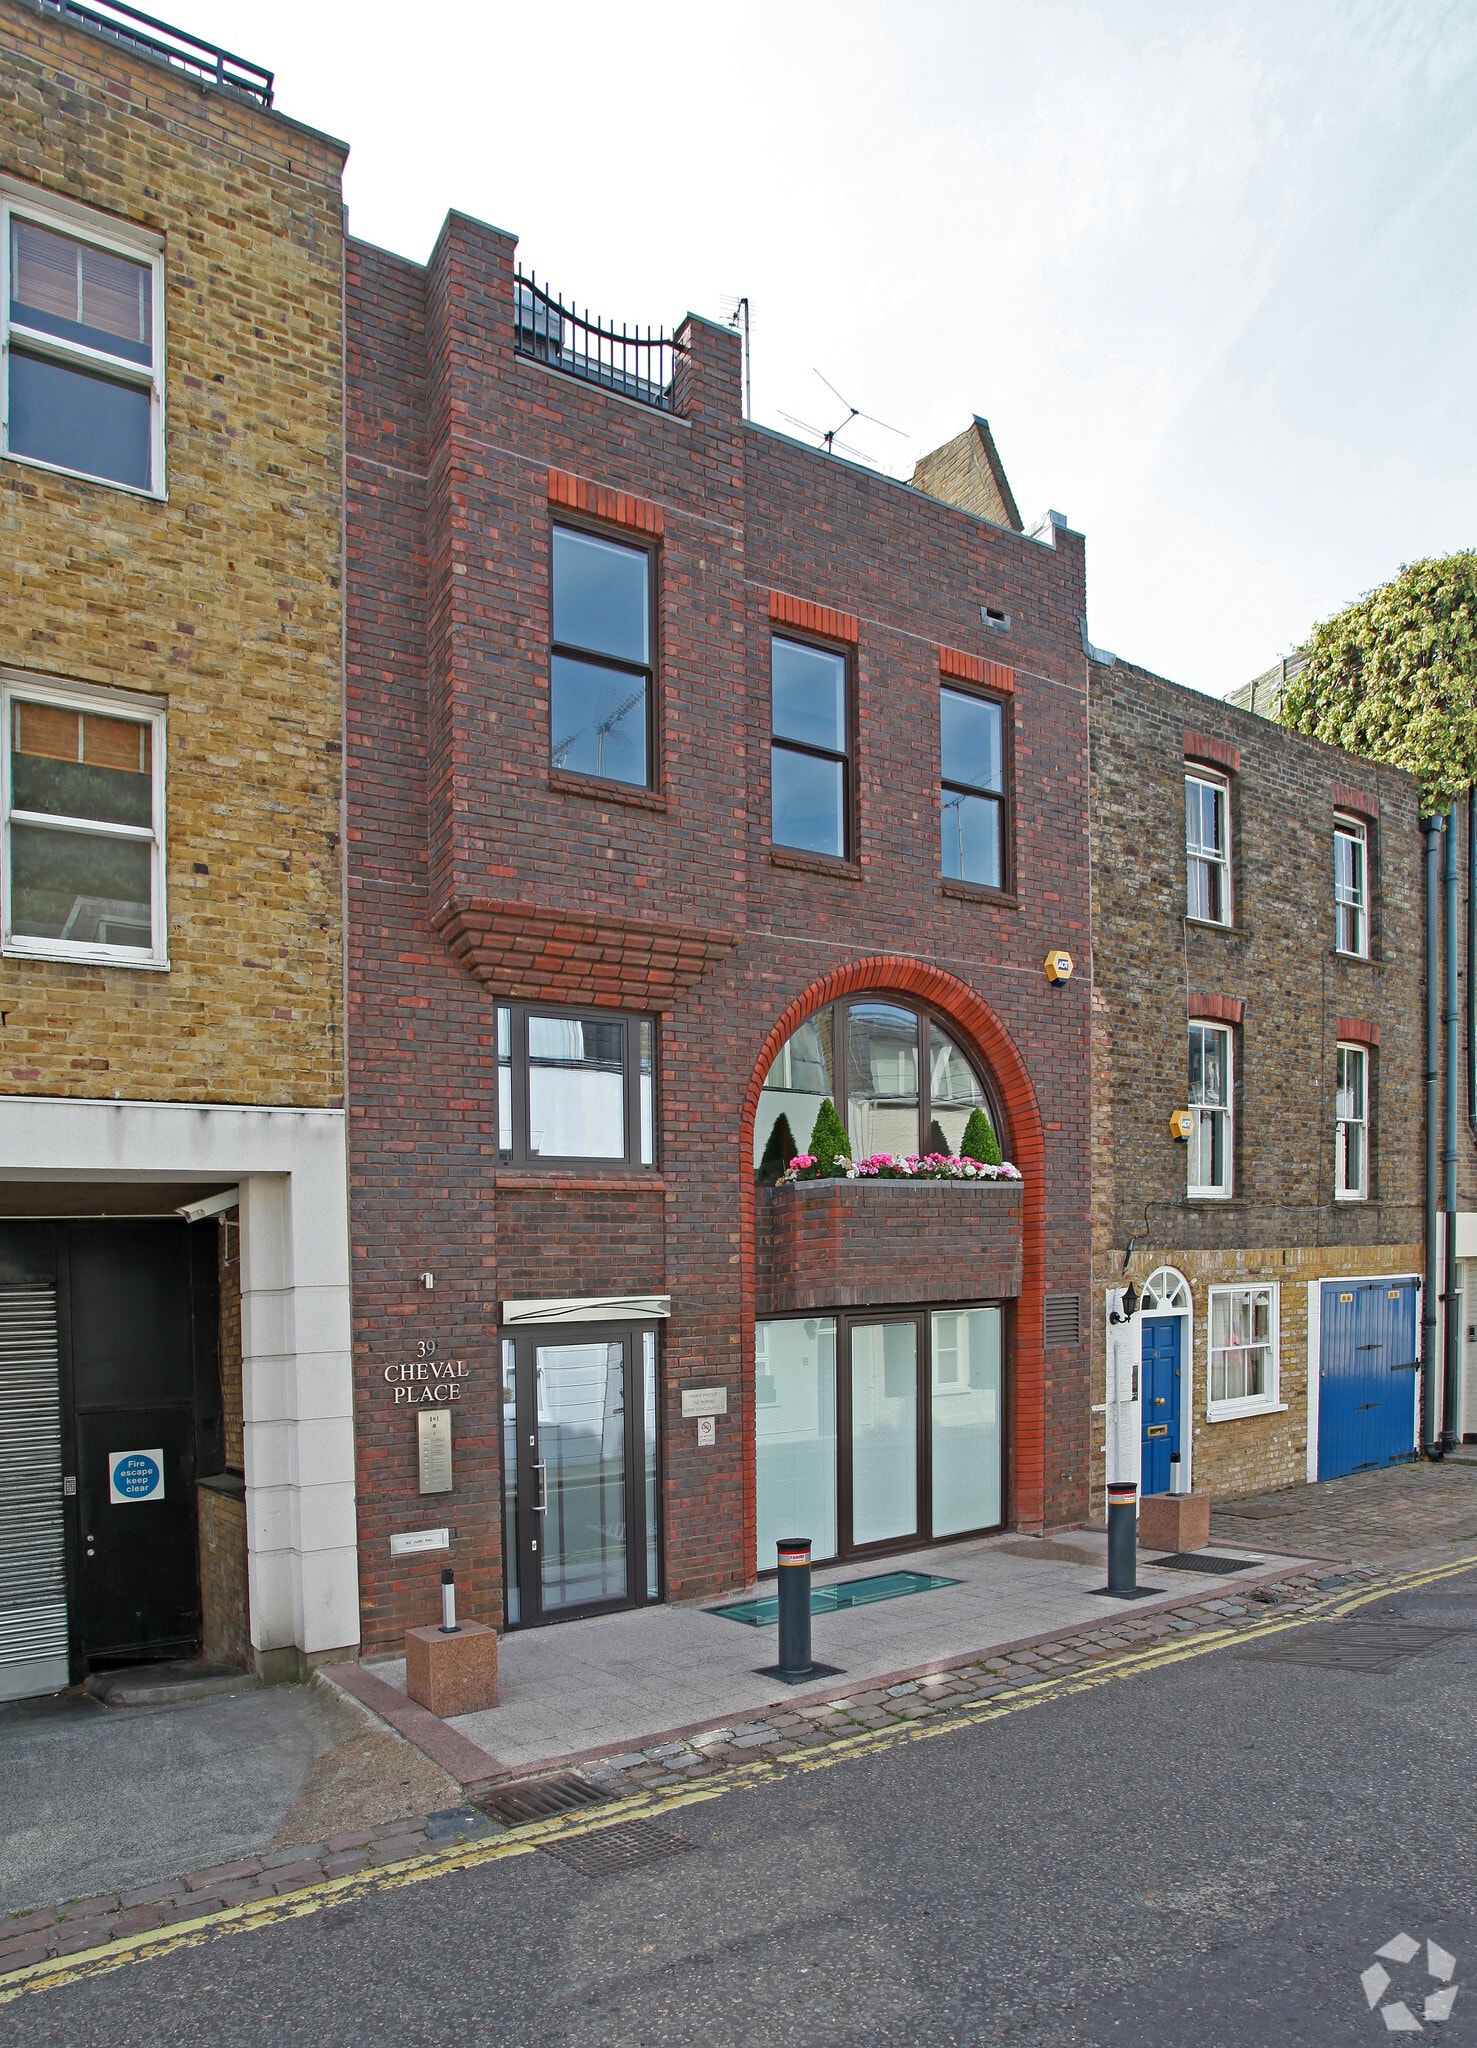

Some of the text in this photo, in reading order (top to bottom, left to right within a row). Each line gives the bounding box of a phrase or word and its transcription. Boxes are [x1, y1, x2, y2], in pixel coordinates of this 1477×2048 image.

[1058, 960, 1068, 970] ADT
[417, 1340, 436, 1358] 39
[384, 1360, 470, 1383] CHEVAL
[393, 1383, 462, 1404] PLACE
[128, 1460, 145, 1468] Fire
[120, 1468, 153, 1477] escape
[126, 1477, 148, 1485] keep
[126, 1485, 149, 1493] clear
